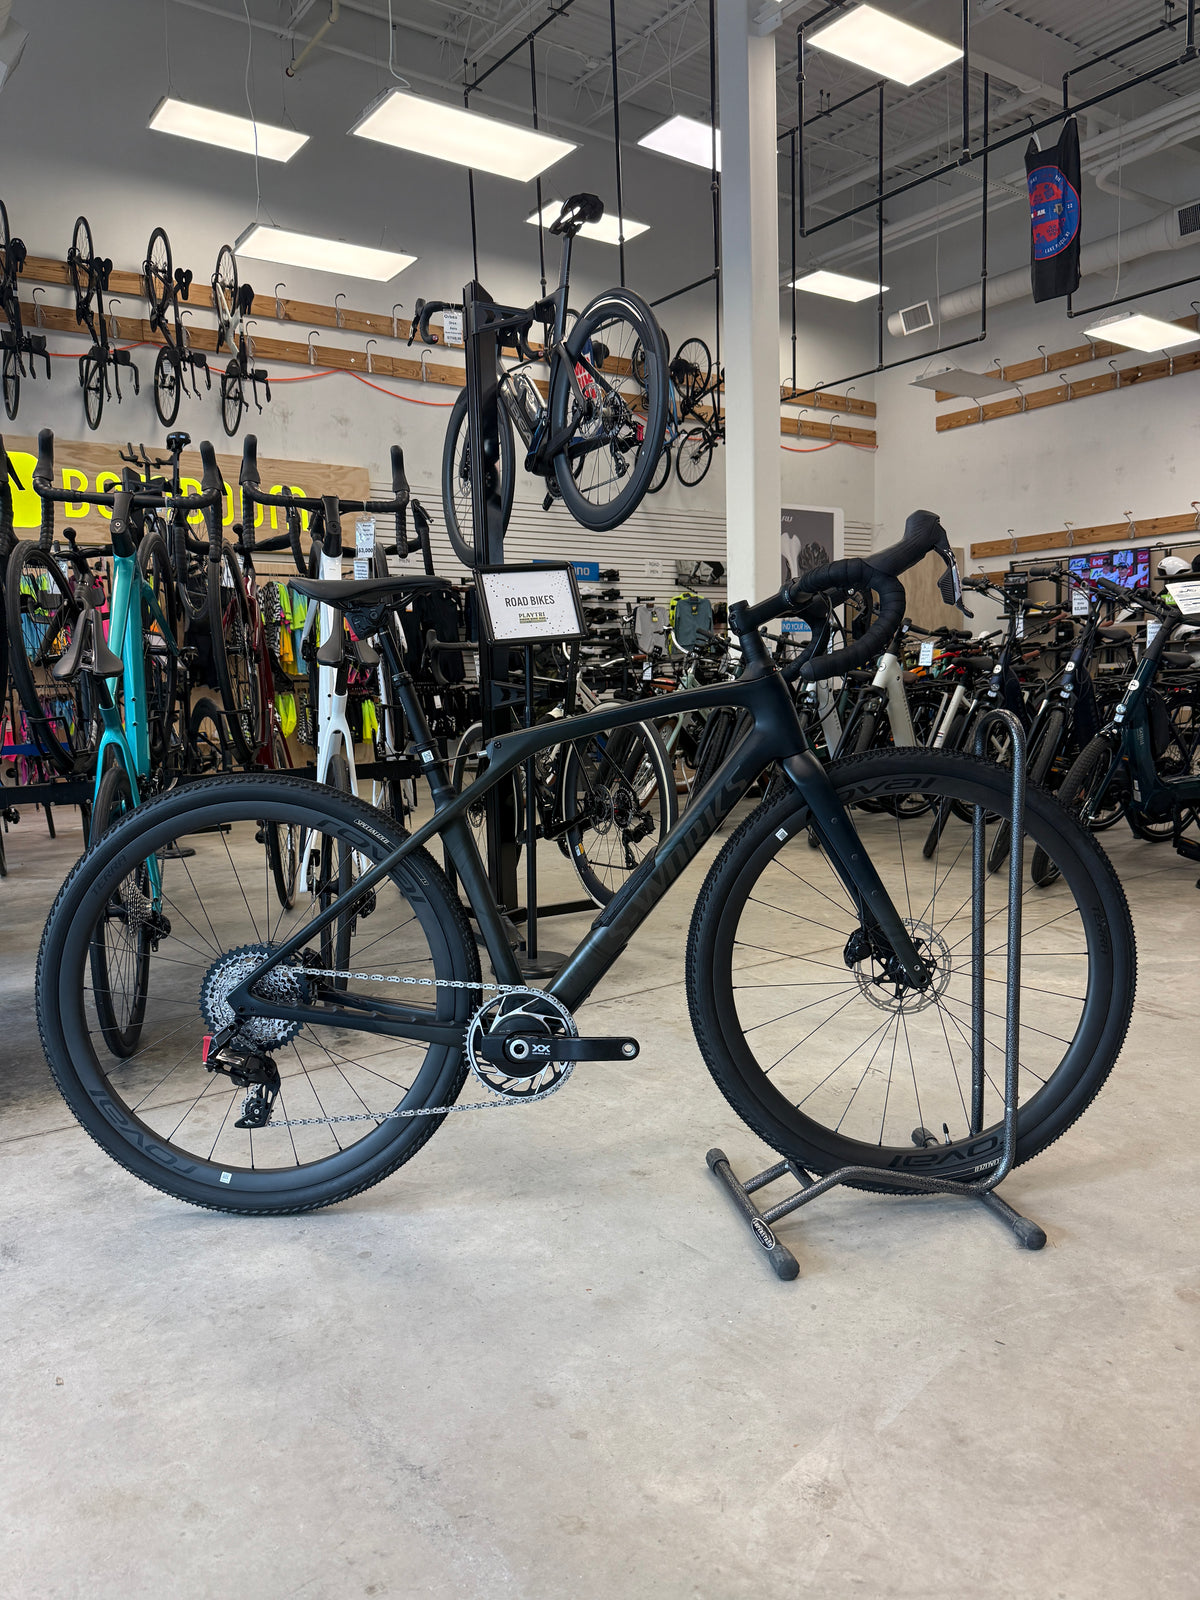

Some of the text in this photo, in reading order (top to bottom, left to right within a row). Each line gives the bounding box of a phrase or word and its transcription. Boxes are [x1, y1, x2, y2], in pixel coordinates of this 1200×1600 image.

[504, 595, 555, 607] ROAD BIKES
[532, 1044, 550, 1053] XX
